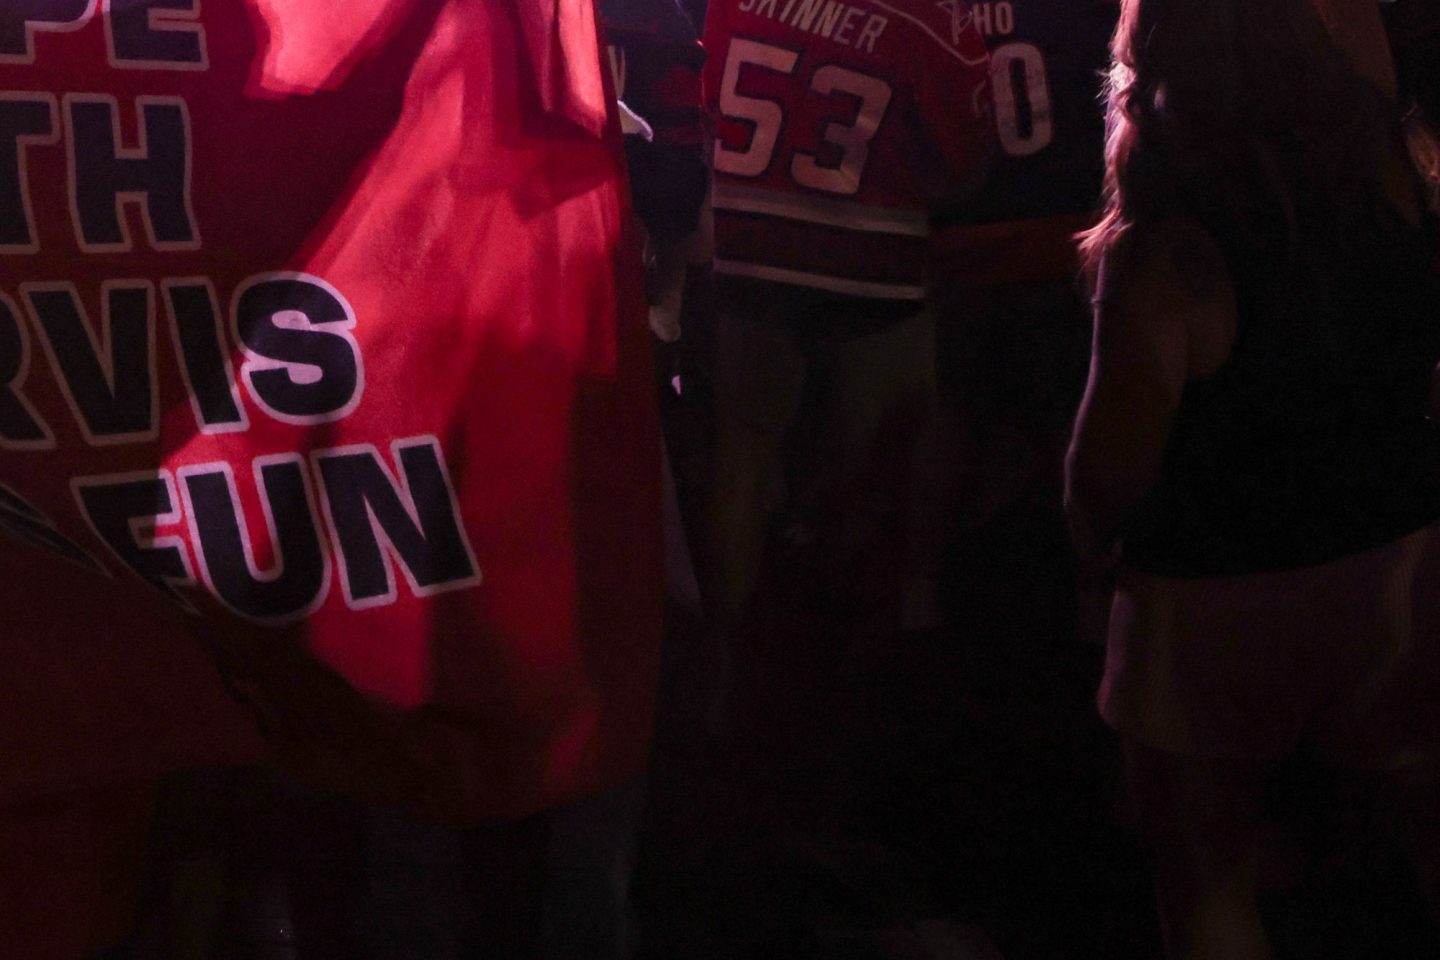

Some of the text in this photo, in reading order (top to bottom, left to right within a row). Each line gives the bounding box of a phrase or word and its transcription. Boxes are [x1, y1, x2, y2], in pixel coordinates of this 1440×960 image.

[971, 0, 1014, 36] HO
[713, 36, 893, 195] 53
[990, 41, 1053, 157] 0
[71, 432, 484, 627] FUN
